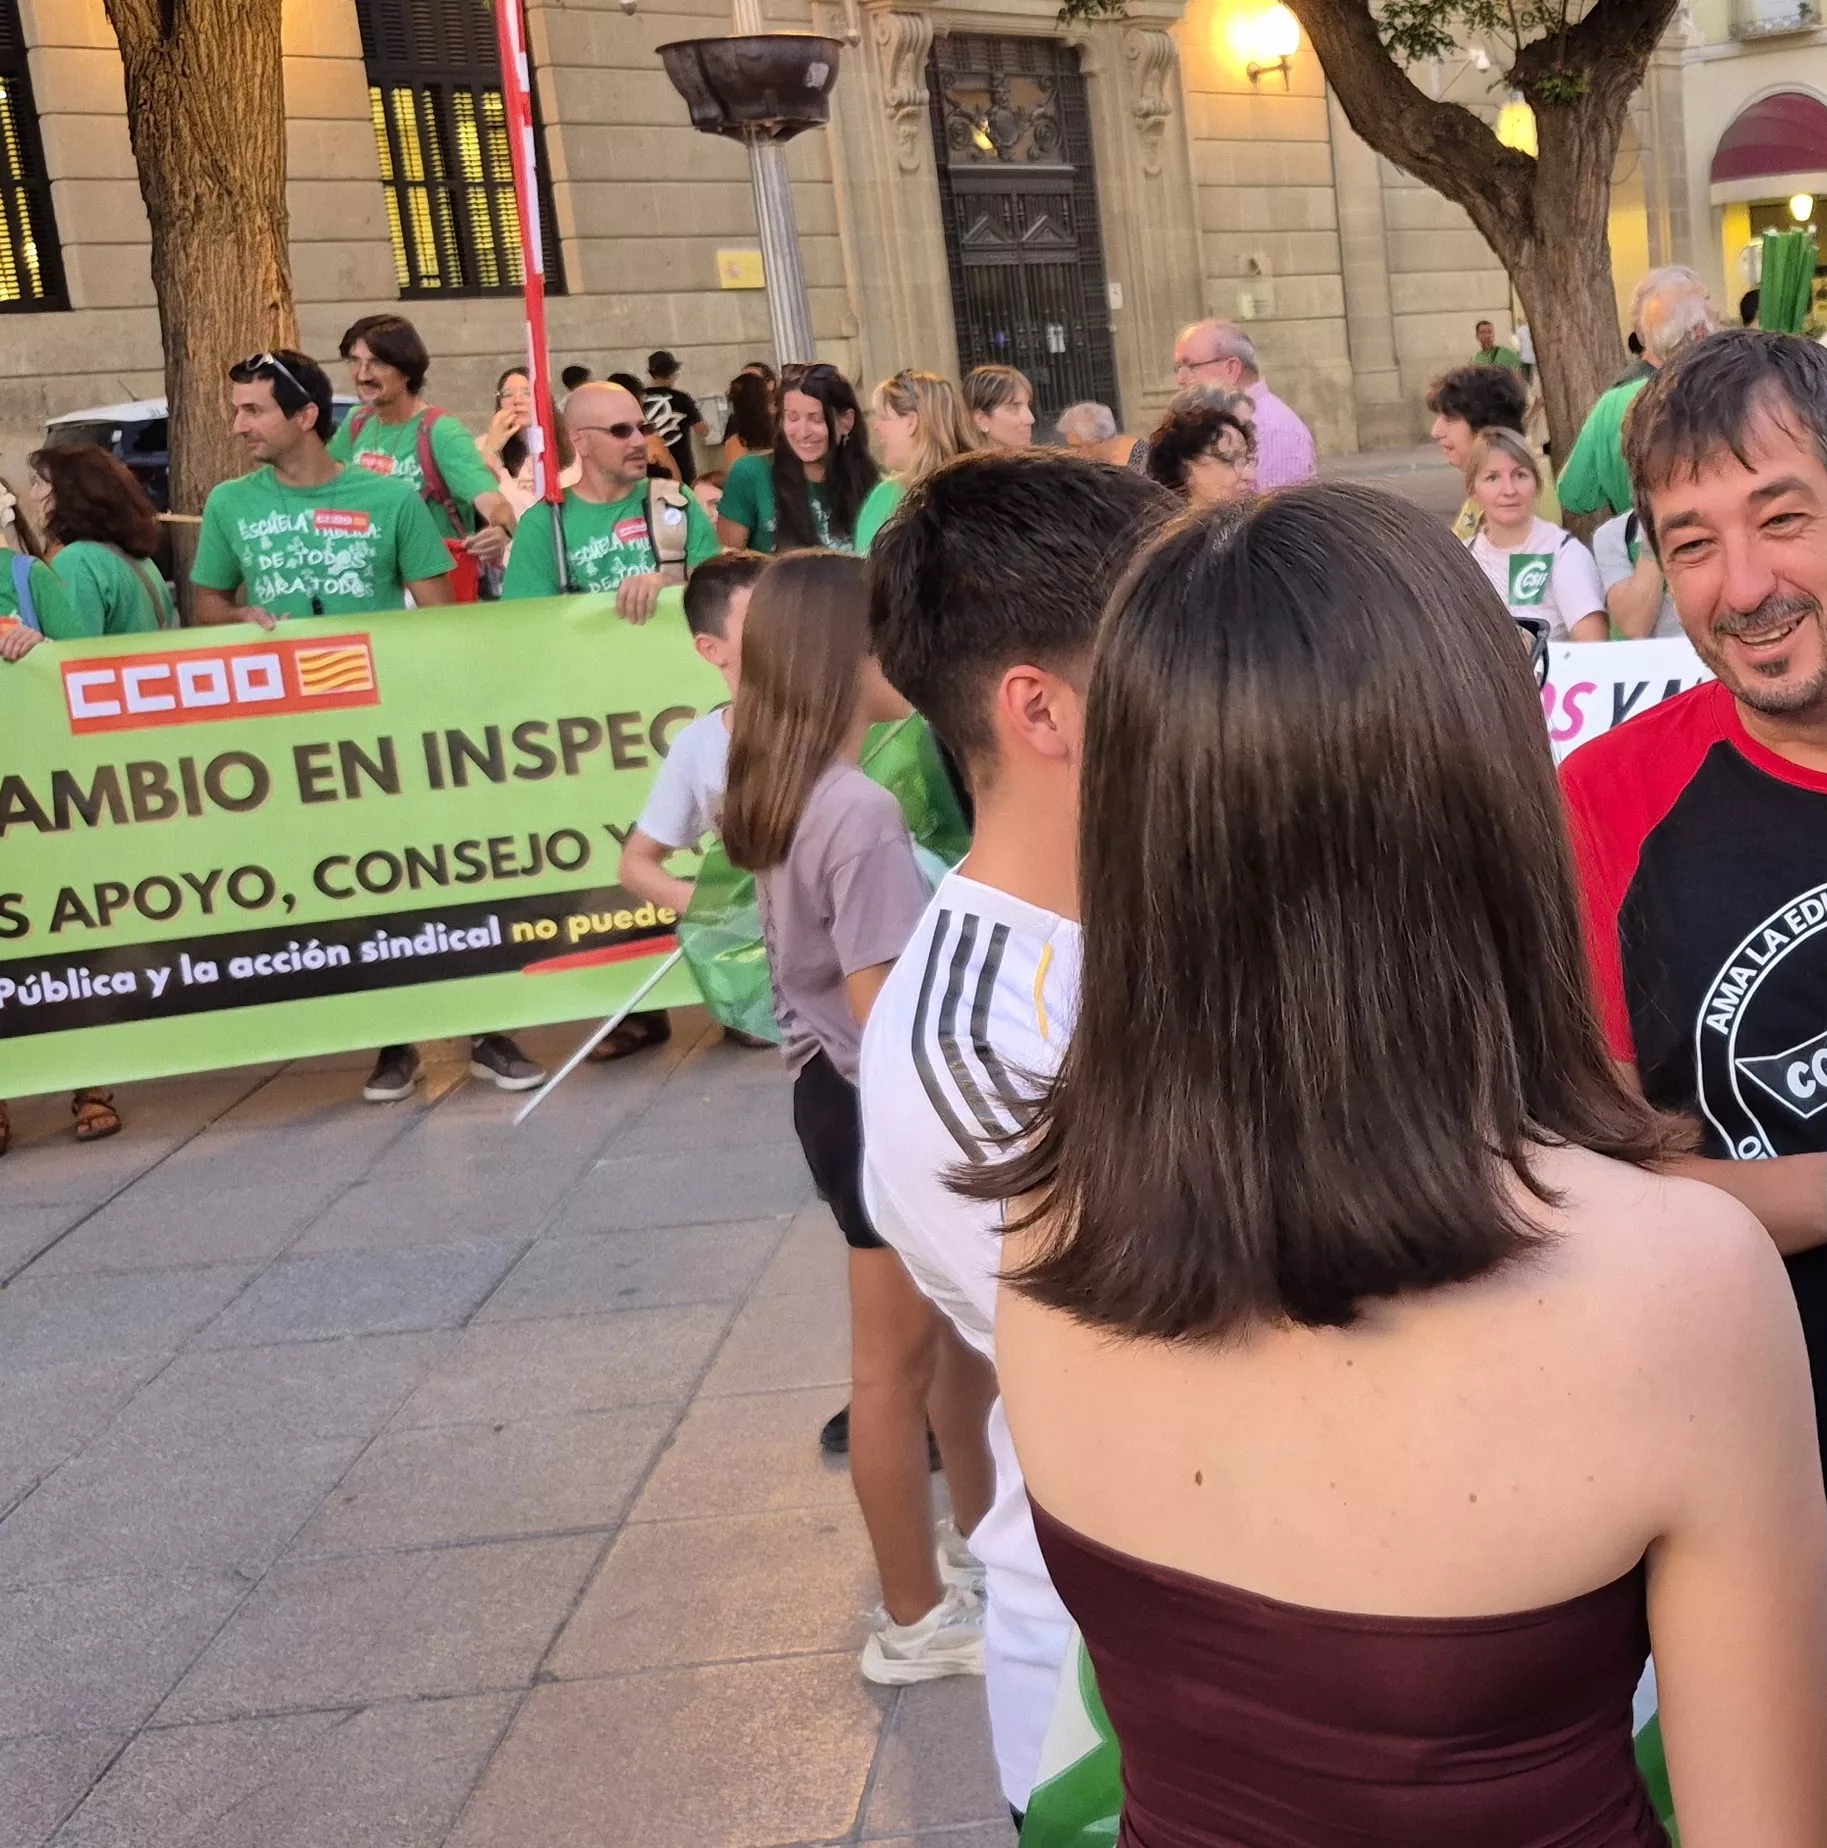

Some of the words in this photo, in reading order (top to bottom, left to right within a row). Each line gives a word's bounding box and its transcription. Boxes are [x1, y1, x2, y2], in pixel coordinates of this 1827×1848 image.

[65, 652, 286, 720] CCOO
[292, 735, 402, 805] EN
[422, 703, 734, 790] INSPEC
[49, 864, 297, 934] APOYO,
[313, 828, 592, 900] CONSEJO
[0, 967, 138, 1010] Pública
[146, 966, 172, 999] y
[180, 953, 219, 986] la
[228, 938, 351, 980] acción
[360, 915, 502, 964] sindical
[511, 917, 558, 943] no
[567, 901, 678, 943] puede
[1706, 964, 1757, 1035] AMA
[1750, 928, 1791, 967] LA
